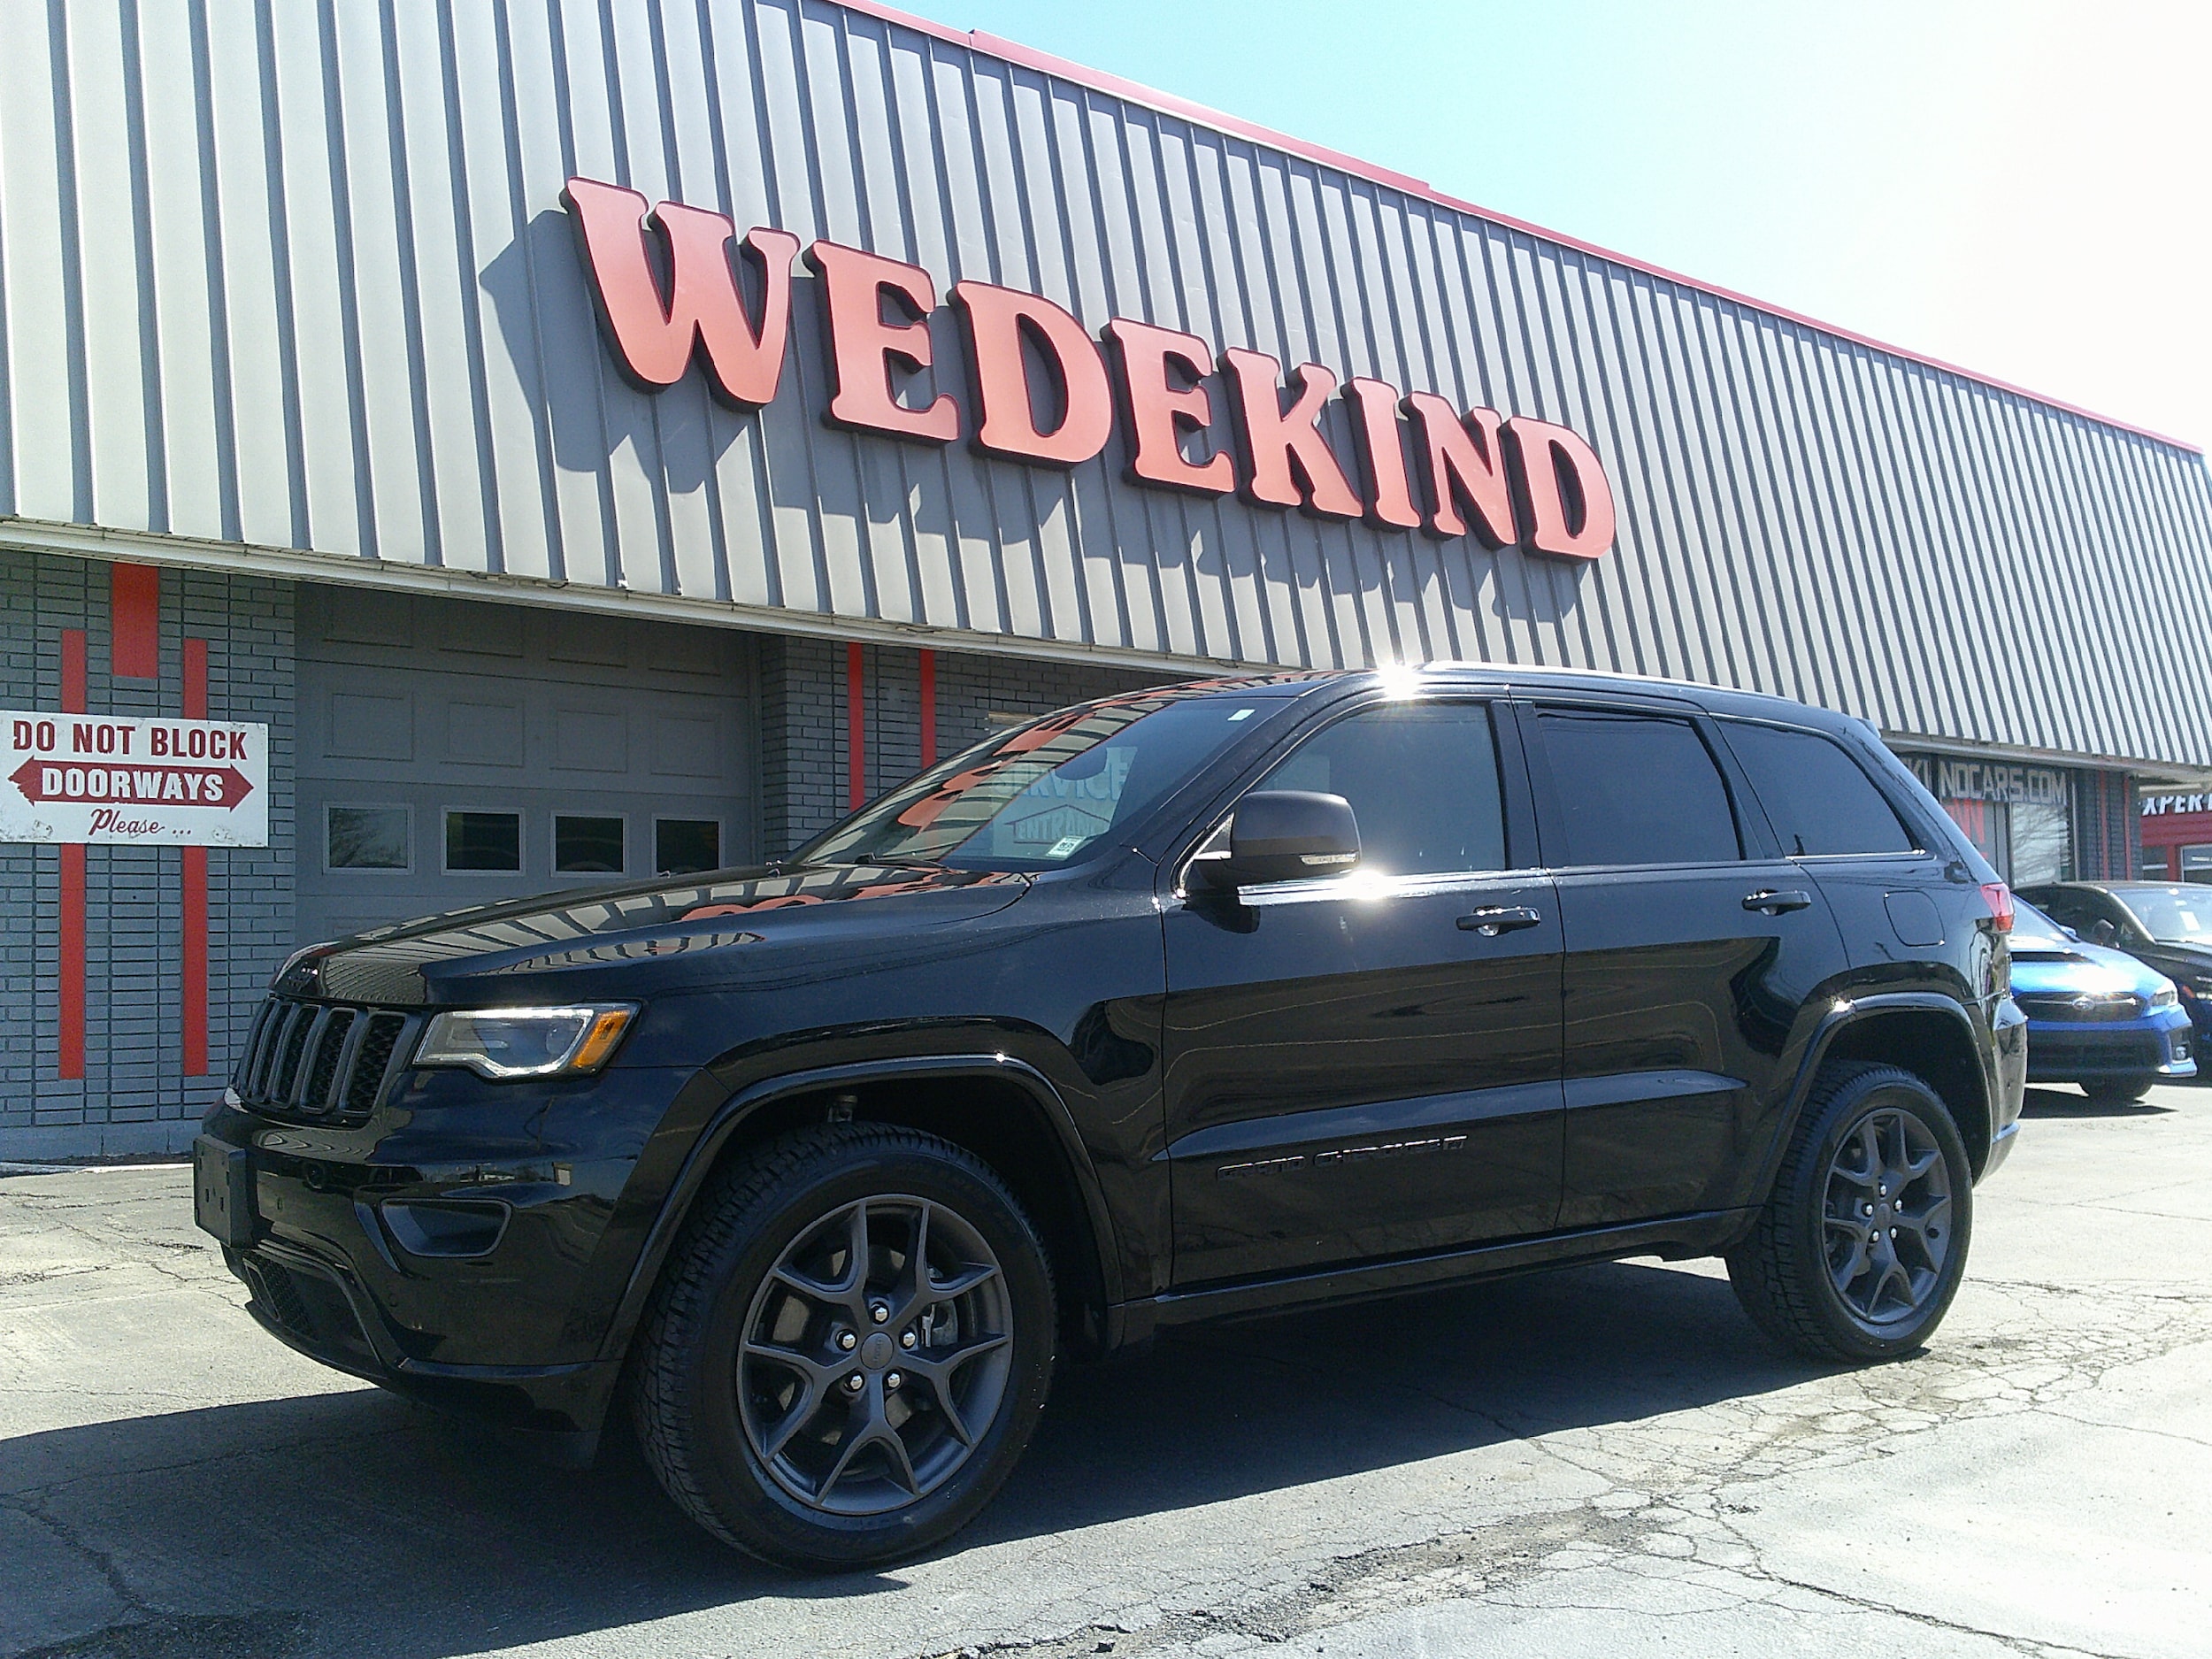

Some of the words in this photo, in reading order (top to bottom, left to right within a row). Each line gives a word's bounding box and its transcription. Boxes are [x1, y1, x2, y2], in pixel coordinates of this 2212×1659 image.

[564, 176, 1615, 565] WEDEKIND
[13, 720, 55, 751] DO
[73, 723, 135, 754] NOT
[150, 727, 248, 760] BLOCK
[42, 767, 224, 802] DOORWAYS
[1901, 757, 2069, 805] KINDCARS.COM
[88, 808, 165, 836] Please
